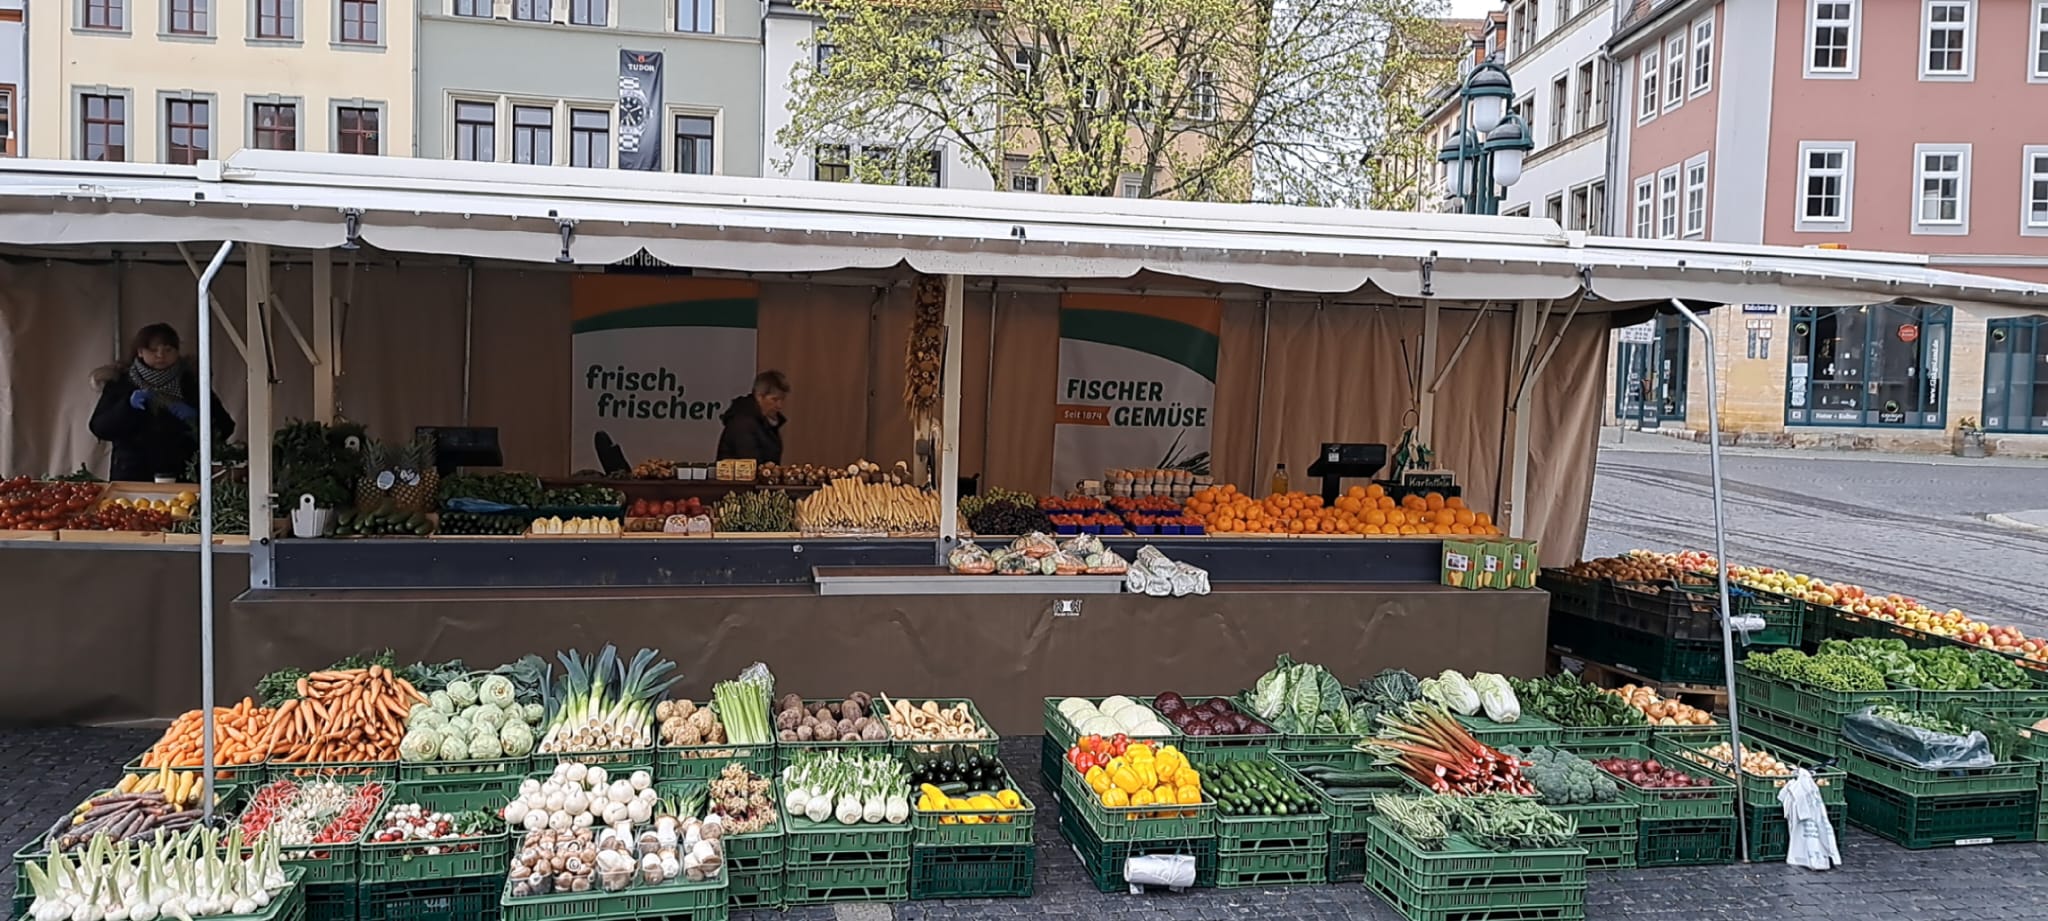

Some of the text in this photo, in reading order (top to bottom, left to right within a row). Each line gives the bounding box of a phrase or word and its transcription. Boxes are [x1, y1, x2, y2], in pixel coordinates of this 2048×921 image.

[628, 63, 655, 72] TUDOR
[586, 364, 685, 398] frisch,
[1067, 378, 1164, 401] FISCHER
[1064, 410, 1081, 419] Seit
[1114, 402, 1208, 427] GEMÜSE
